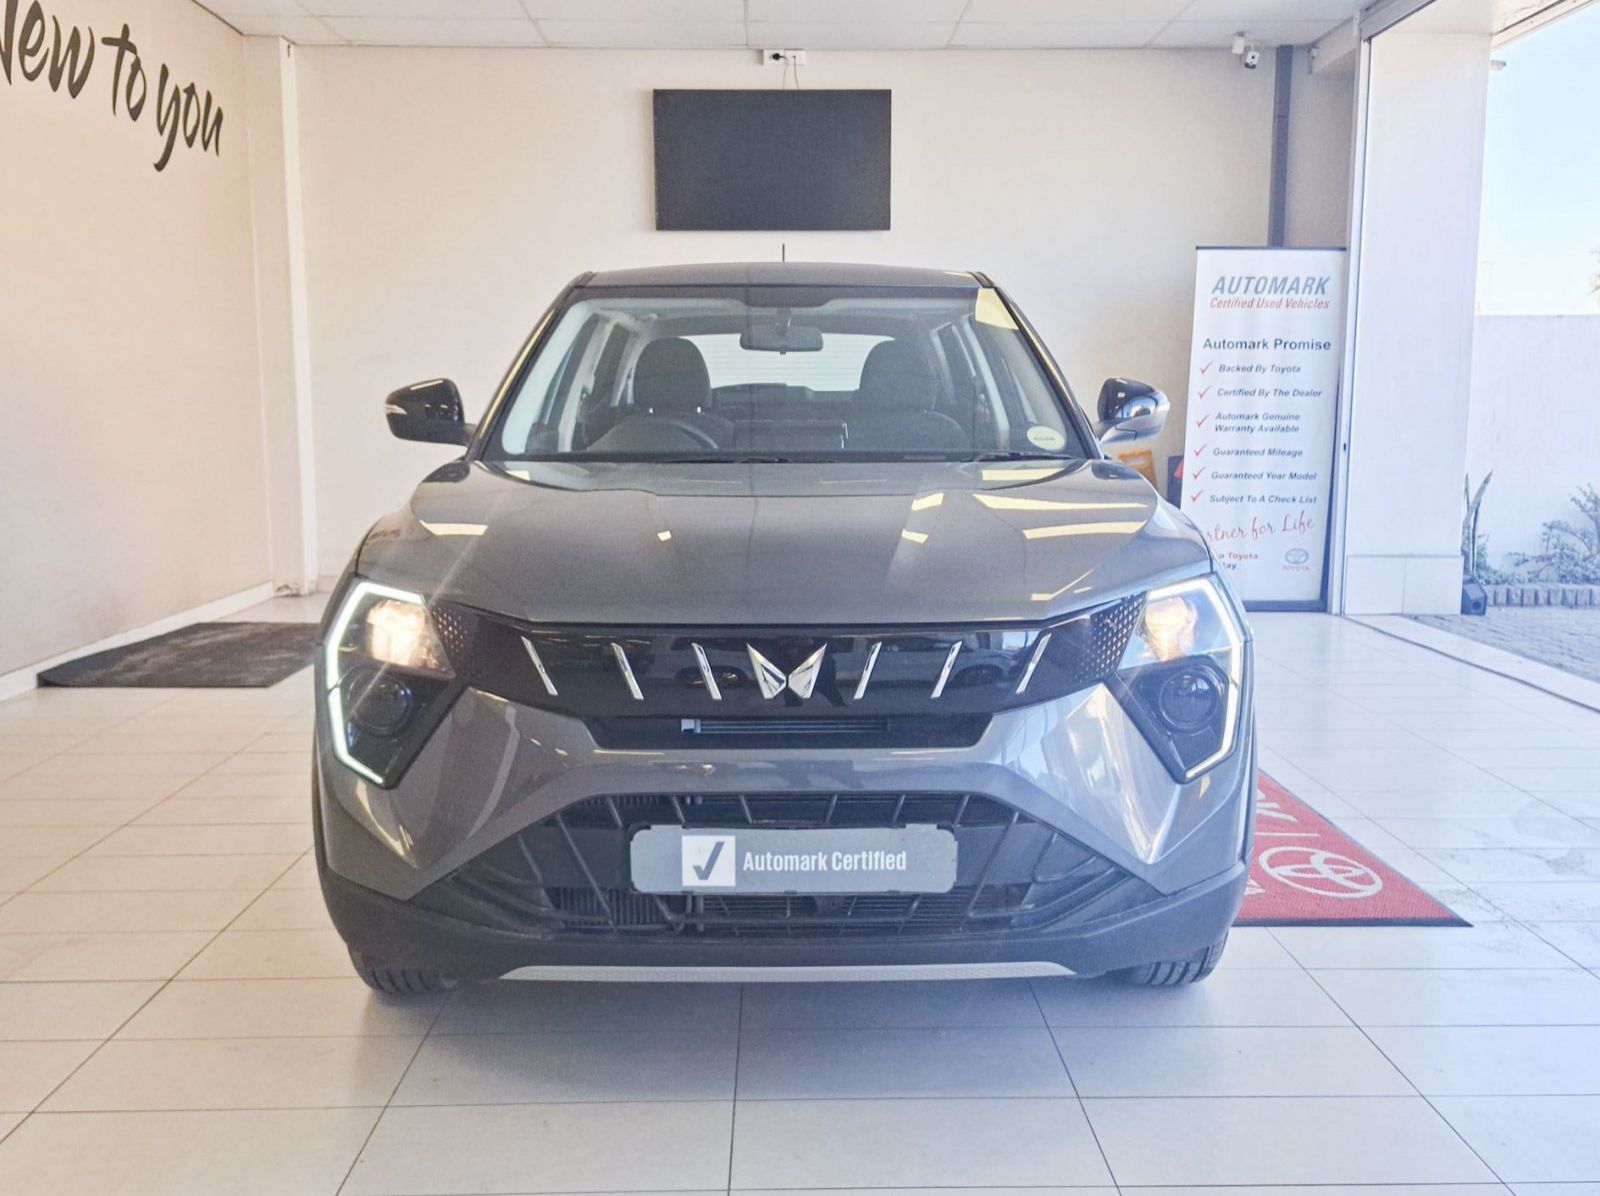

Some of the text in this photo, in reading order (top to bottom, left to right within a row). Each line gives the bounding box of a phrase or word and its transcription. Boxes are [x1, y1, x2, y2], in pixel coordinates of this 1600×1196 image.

[101, 23, 147, 122] to
[153, 63, 223, 173] you
[1211, 275, 1331, 296] AUTOMARK
[1209, 297, 1330, 310] Certified Used Vehicles
[1203, 337, 1332, 351] Automark Promise
[1218, 364, 1301, 375] Backed By Toyota
[1217, 388, 1322, 398] Certified By The Dealer
[1215, 412, 1301, 421] Automark Genuine
[1214, 424, 1300, 434] Warranty Available
[1213, 447, 1303, 458] Guaranteed Mileage
[1211, 471, 1318, 480] Guaranteed Year Model
[1209, 494, 1318, 505] Subject To A Check List
[1250, 515, 1277, 541] for
[1281, 510, 1316, 535] Life
[1228, 552, 1259, 561] Toyota
[743, 851, 906, 872] Automark Certified
